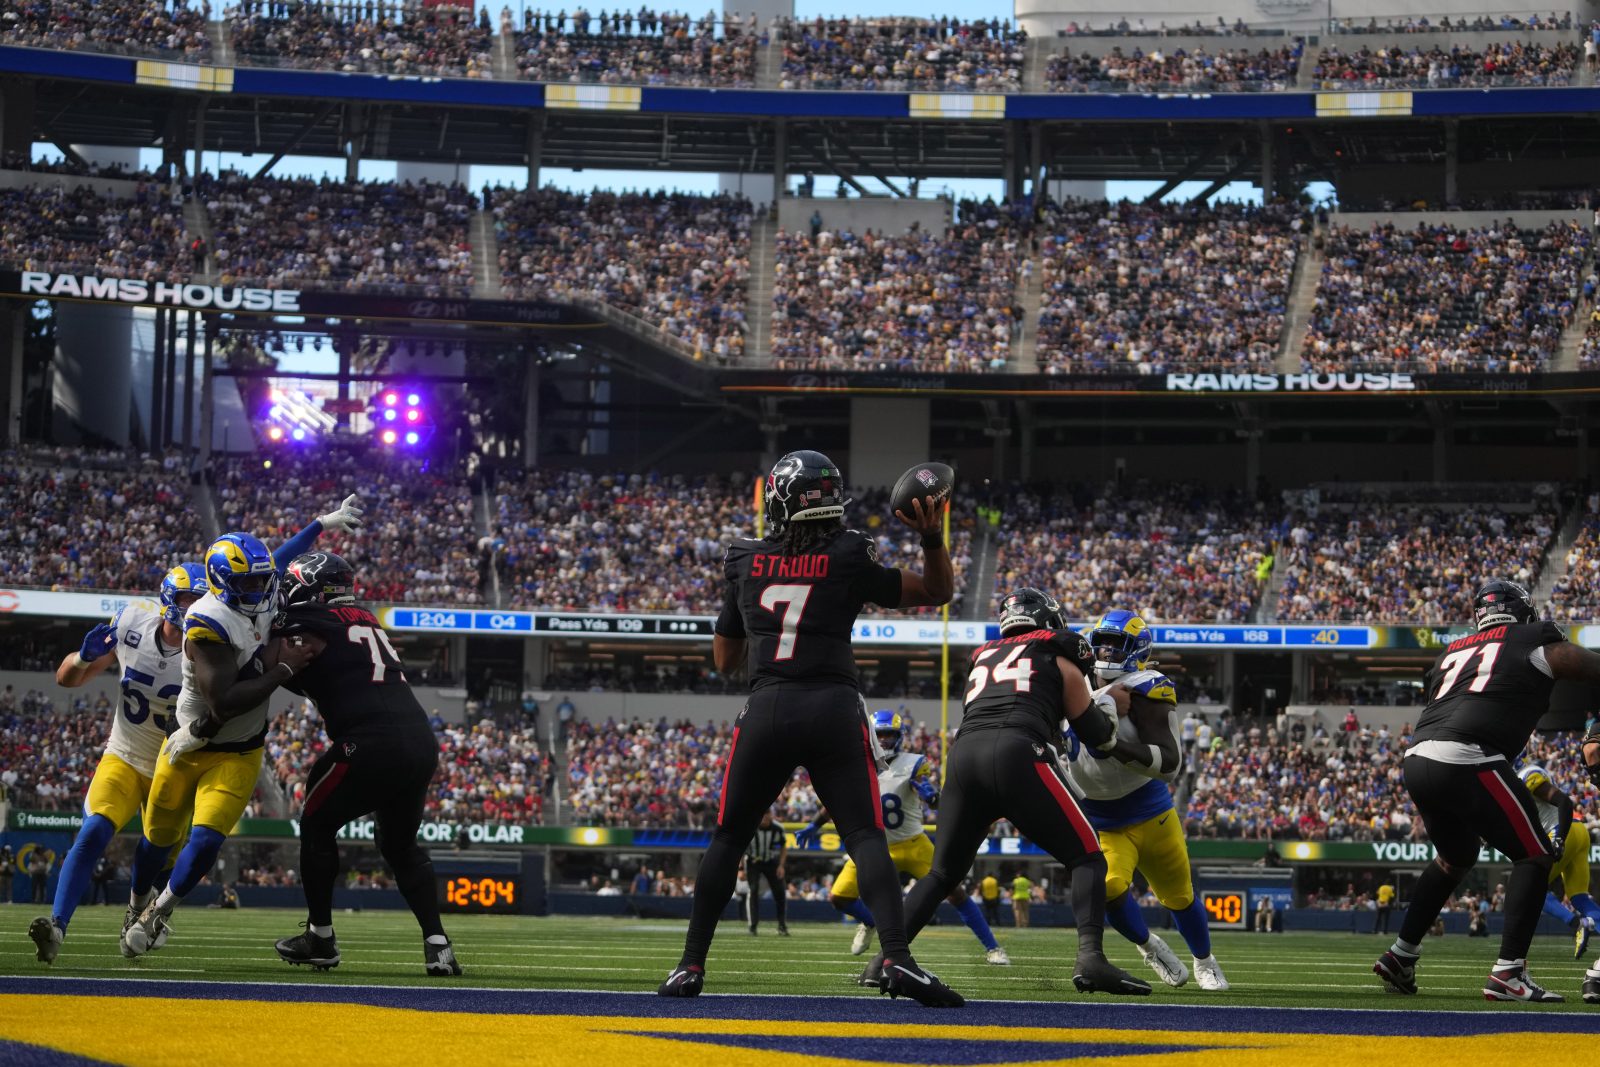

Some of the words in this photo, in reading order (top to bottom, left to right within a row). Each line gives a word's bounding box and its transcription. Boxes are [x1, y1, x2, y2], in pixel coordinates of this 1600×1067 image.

[21, 271, 148, 301] RAMS
[154, 282, 300, 311] HOUSE
[1166, 373, 1279, 391] RAMS
[1285, 373, 1415, 391] HOUSE
[804, 509, 843, 518] HOUSTON
[751, 554, 829, 578] STROUD
[412, 612, 456, 627] 12:04
[549, 618, 582, 630] Pass
[583, 618, 609, 631] Yds
[617, 619, 643, 632] 109
[760, 583, 814, 662] 7
[876, 625, 896, 638] 10
[966, 627, 976, 639] 5
[1479, 616, 1512, 627] HOUSTON
[1165, 629, 1198, 642] Pass
[1199, 629, 1225, 642] Yds
[1243, 630, 1269, 642] 168
[1447, 625, 1508, 652] HOWARD
[964, 644, 1038, 706] 54
[1434, 642, 1504, 700] 71
[27, 814, 70, 826] freedom
[1372, 842, 1428, 861] YOUR
[447, 877, 514, 907] 12:04
[1205, 895, 1241, 923] 40
